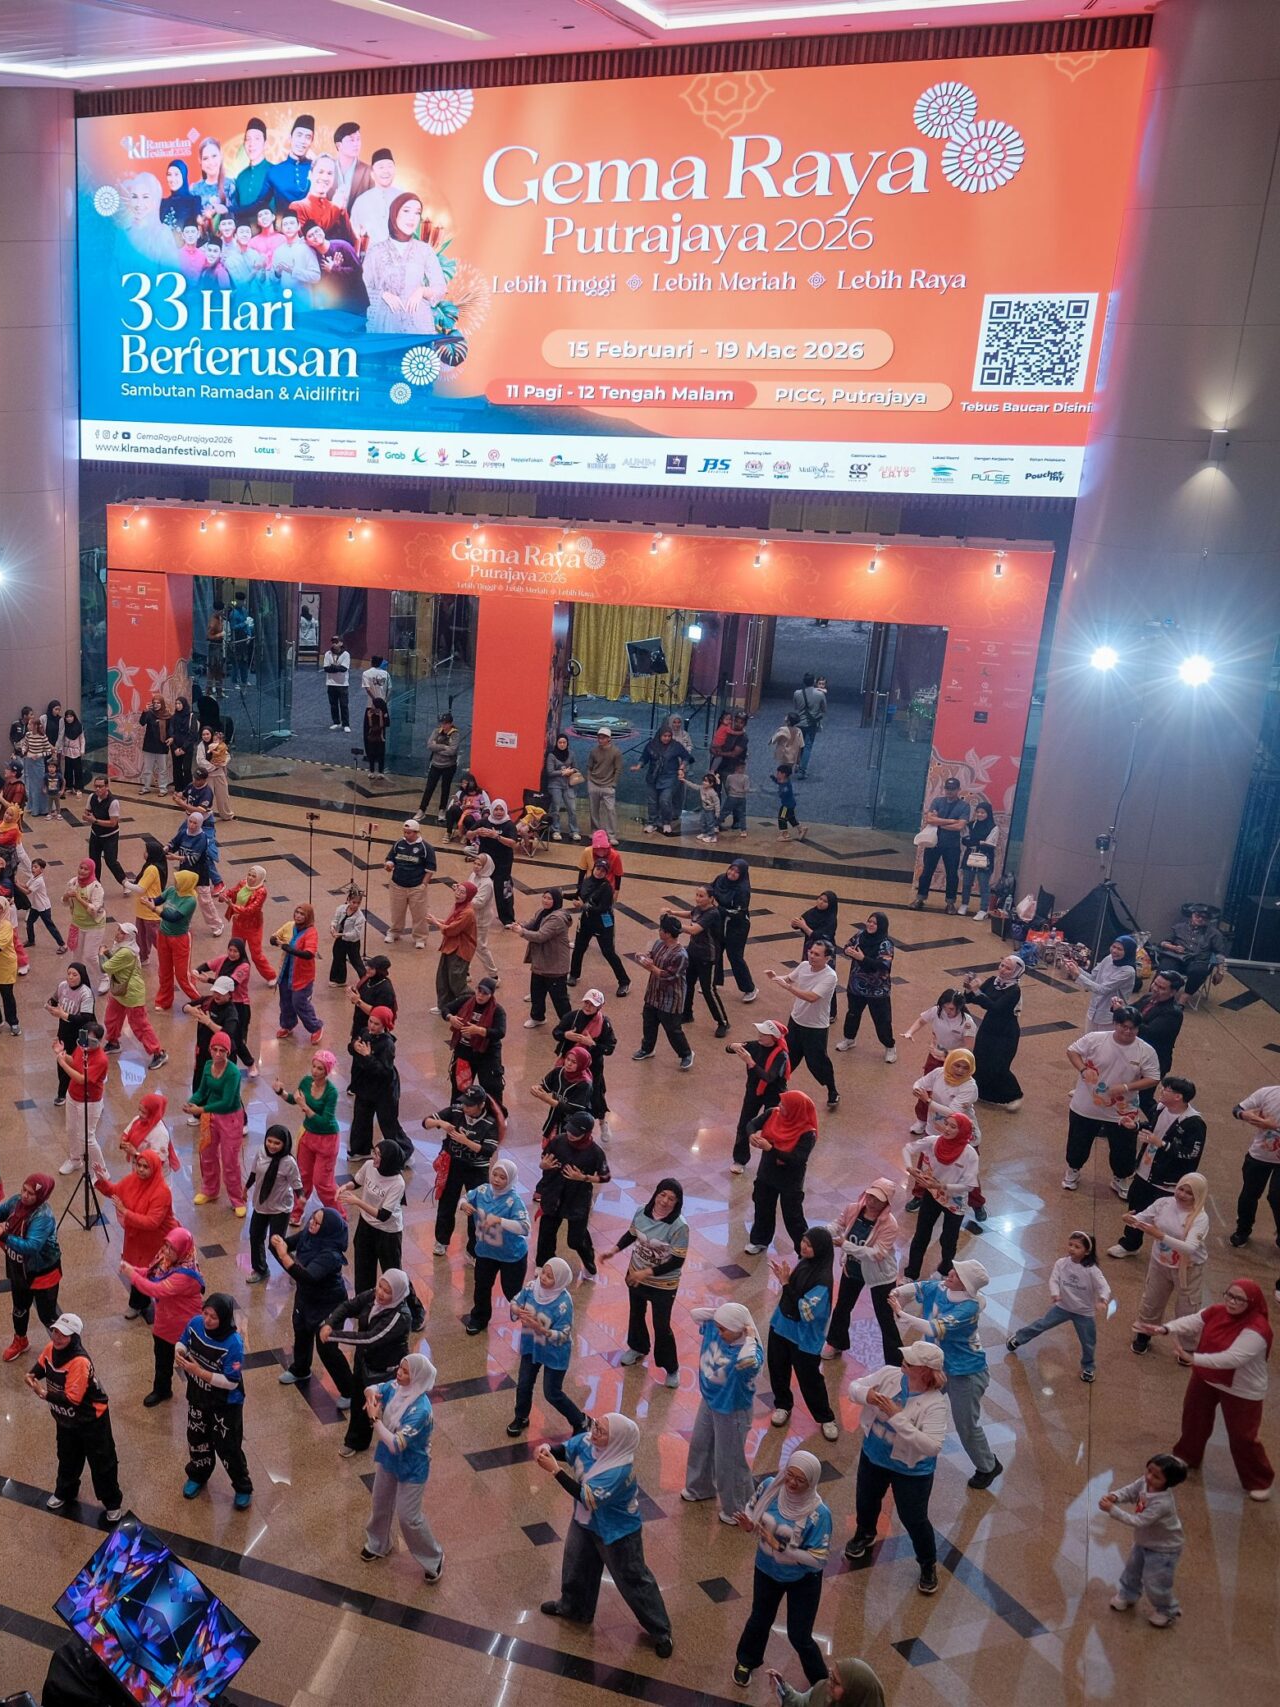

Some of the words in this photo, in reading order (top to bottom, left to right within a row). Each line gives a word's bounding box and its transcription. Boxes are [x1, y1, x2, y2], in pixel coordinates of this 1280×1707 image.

[482, 145, 709, 207] Gema
[723, 134, 930, 218] Raya
[542, 213, 769, 265] Putrajaya
[774, 216, 874, 252] 2026
[492, 275, 547, 294] Lebih
[553, 274, 617, 297] Tinggi
[652, 272, 713, 293] Lebih
[718, 270, 797, 292] Meriah
[837, 269, 902, 290] Lebih
[909, 269, 967, 295] Raya
[120, 271, 189, 332] 33
[200, 288, 295, 331] Hari
[120, 334, 360, 378] Berterusan
[568, 341, 590, 359] 15
[596, 340, 694, 359] Februari
[715, 341, 739, 360] 19
[746, 341, 797, 360] Mac
[803, 342, 865, 360] 2026
[120, 382, 196, 399] Sambutan
[200, 384, 274, 400] Ramadan
[278, 387, 290, 401] &
[293, 386, 360, 402] Aidilfitri
[506, 384, 519, 399] 11
[524, 385, 563, 402] Pagi
[578, 385, 595, 400] 12
[599, 386, 666, 403] Tengah
[672, 387, 734, 402] Malam
[775, 388, 826, 405] PICC,
[832, 388, 928, 407] Putrajaya
[960, 402, 1000, 413] Tebus
[1003, 402, 1051, 413] Baucar
[95, 443, 236, 459] www.klramadanfestival.com
[384, 451, 406, 461] Grab
[971, 473, 1011, 482] PULSE
[450, 540, 520, 565] Gema
[523, 545, 581, 576] Raya
[470, 564, 537, 585] Putrajaya
